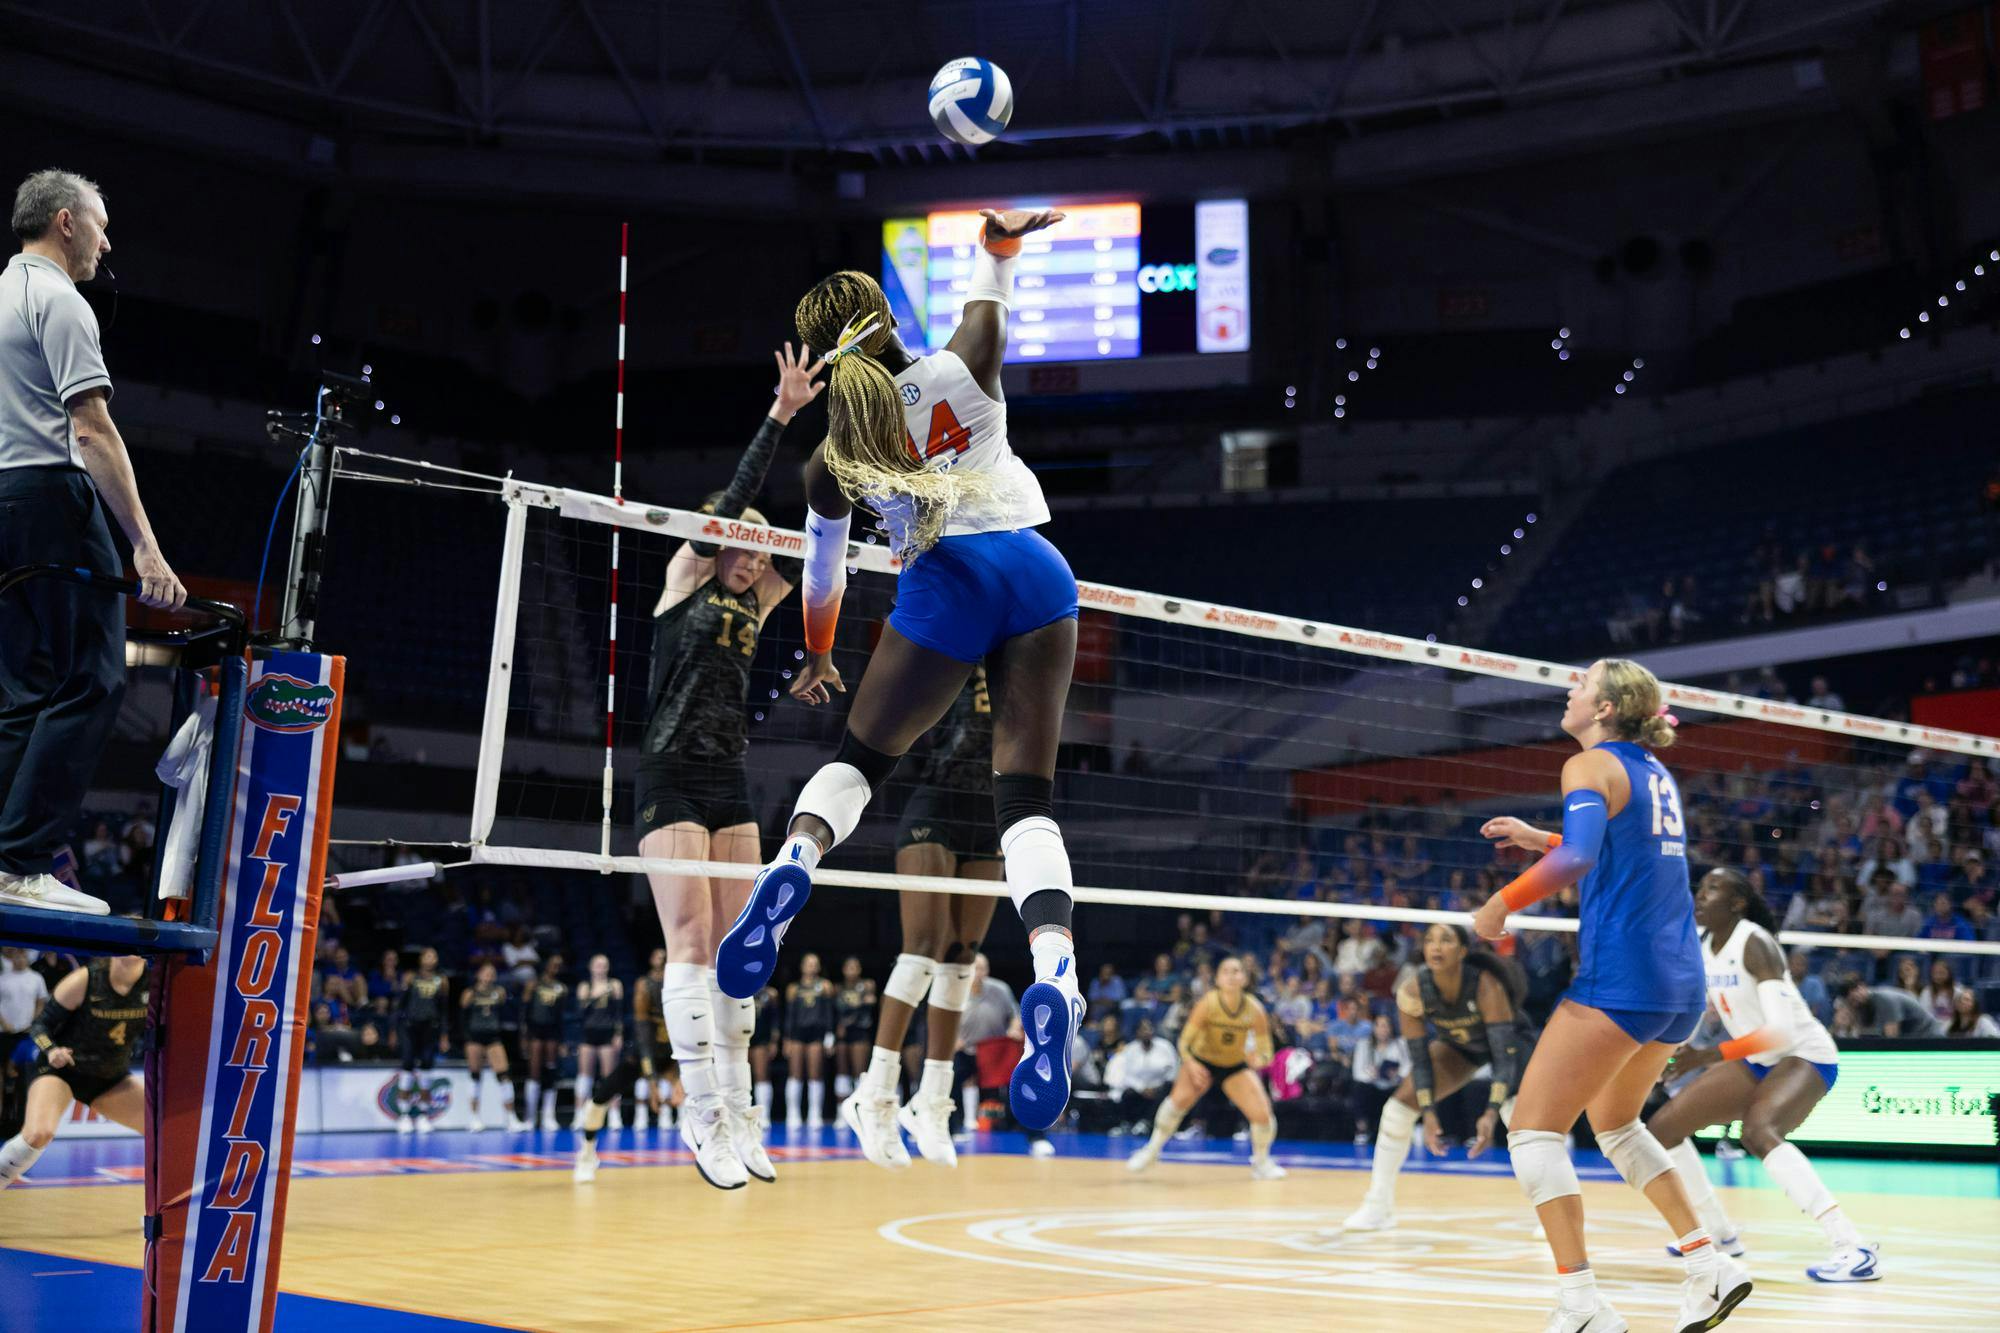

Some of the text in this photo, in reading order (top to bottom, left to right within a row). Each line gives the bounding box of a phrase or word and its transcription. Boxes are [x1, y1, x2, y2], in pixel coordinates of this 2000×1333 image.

[706, 611, 757, 658] 14
[1647, 773, 1684, 837] 13
[108, 1021, 128, 1046] 4
[199, 792, 302, 1284] FLORIDA
